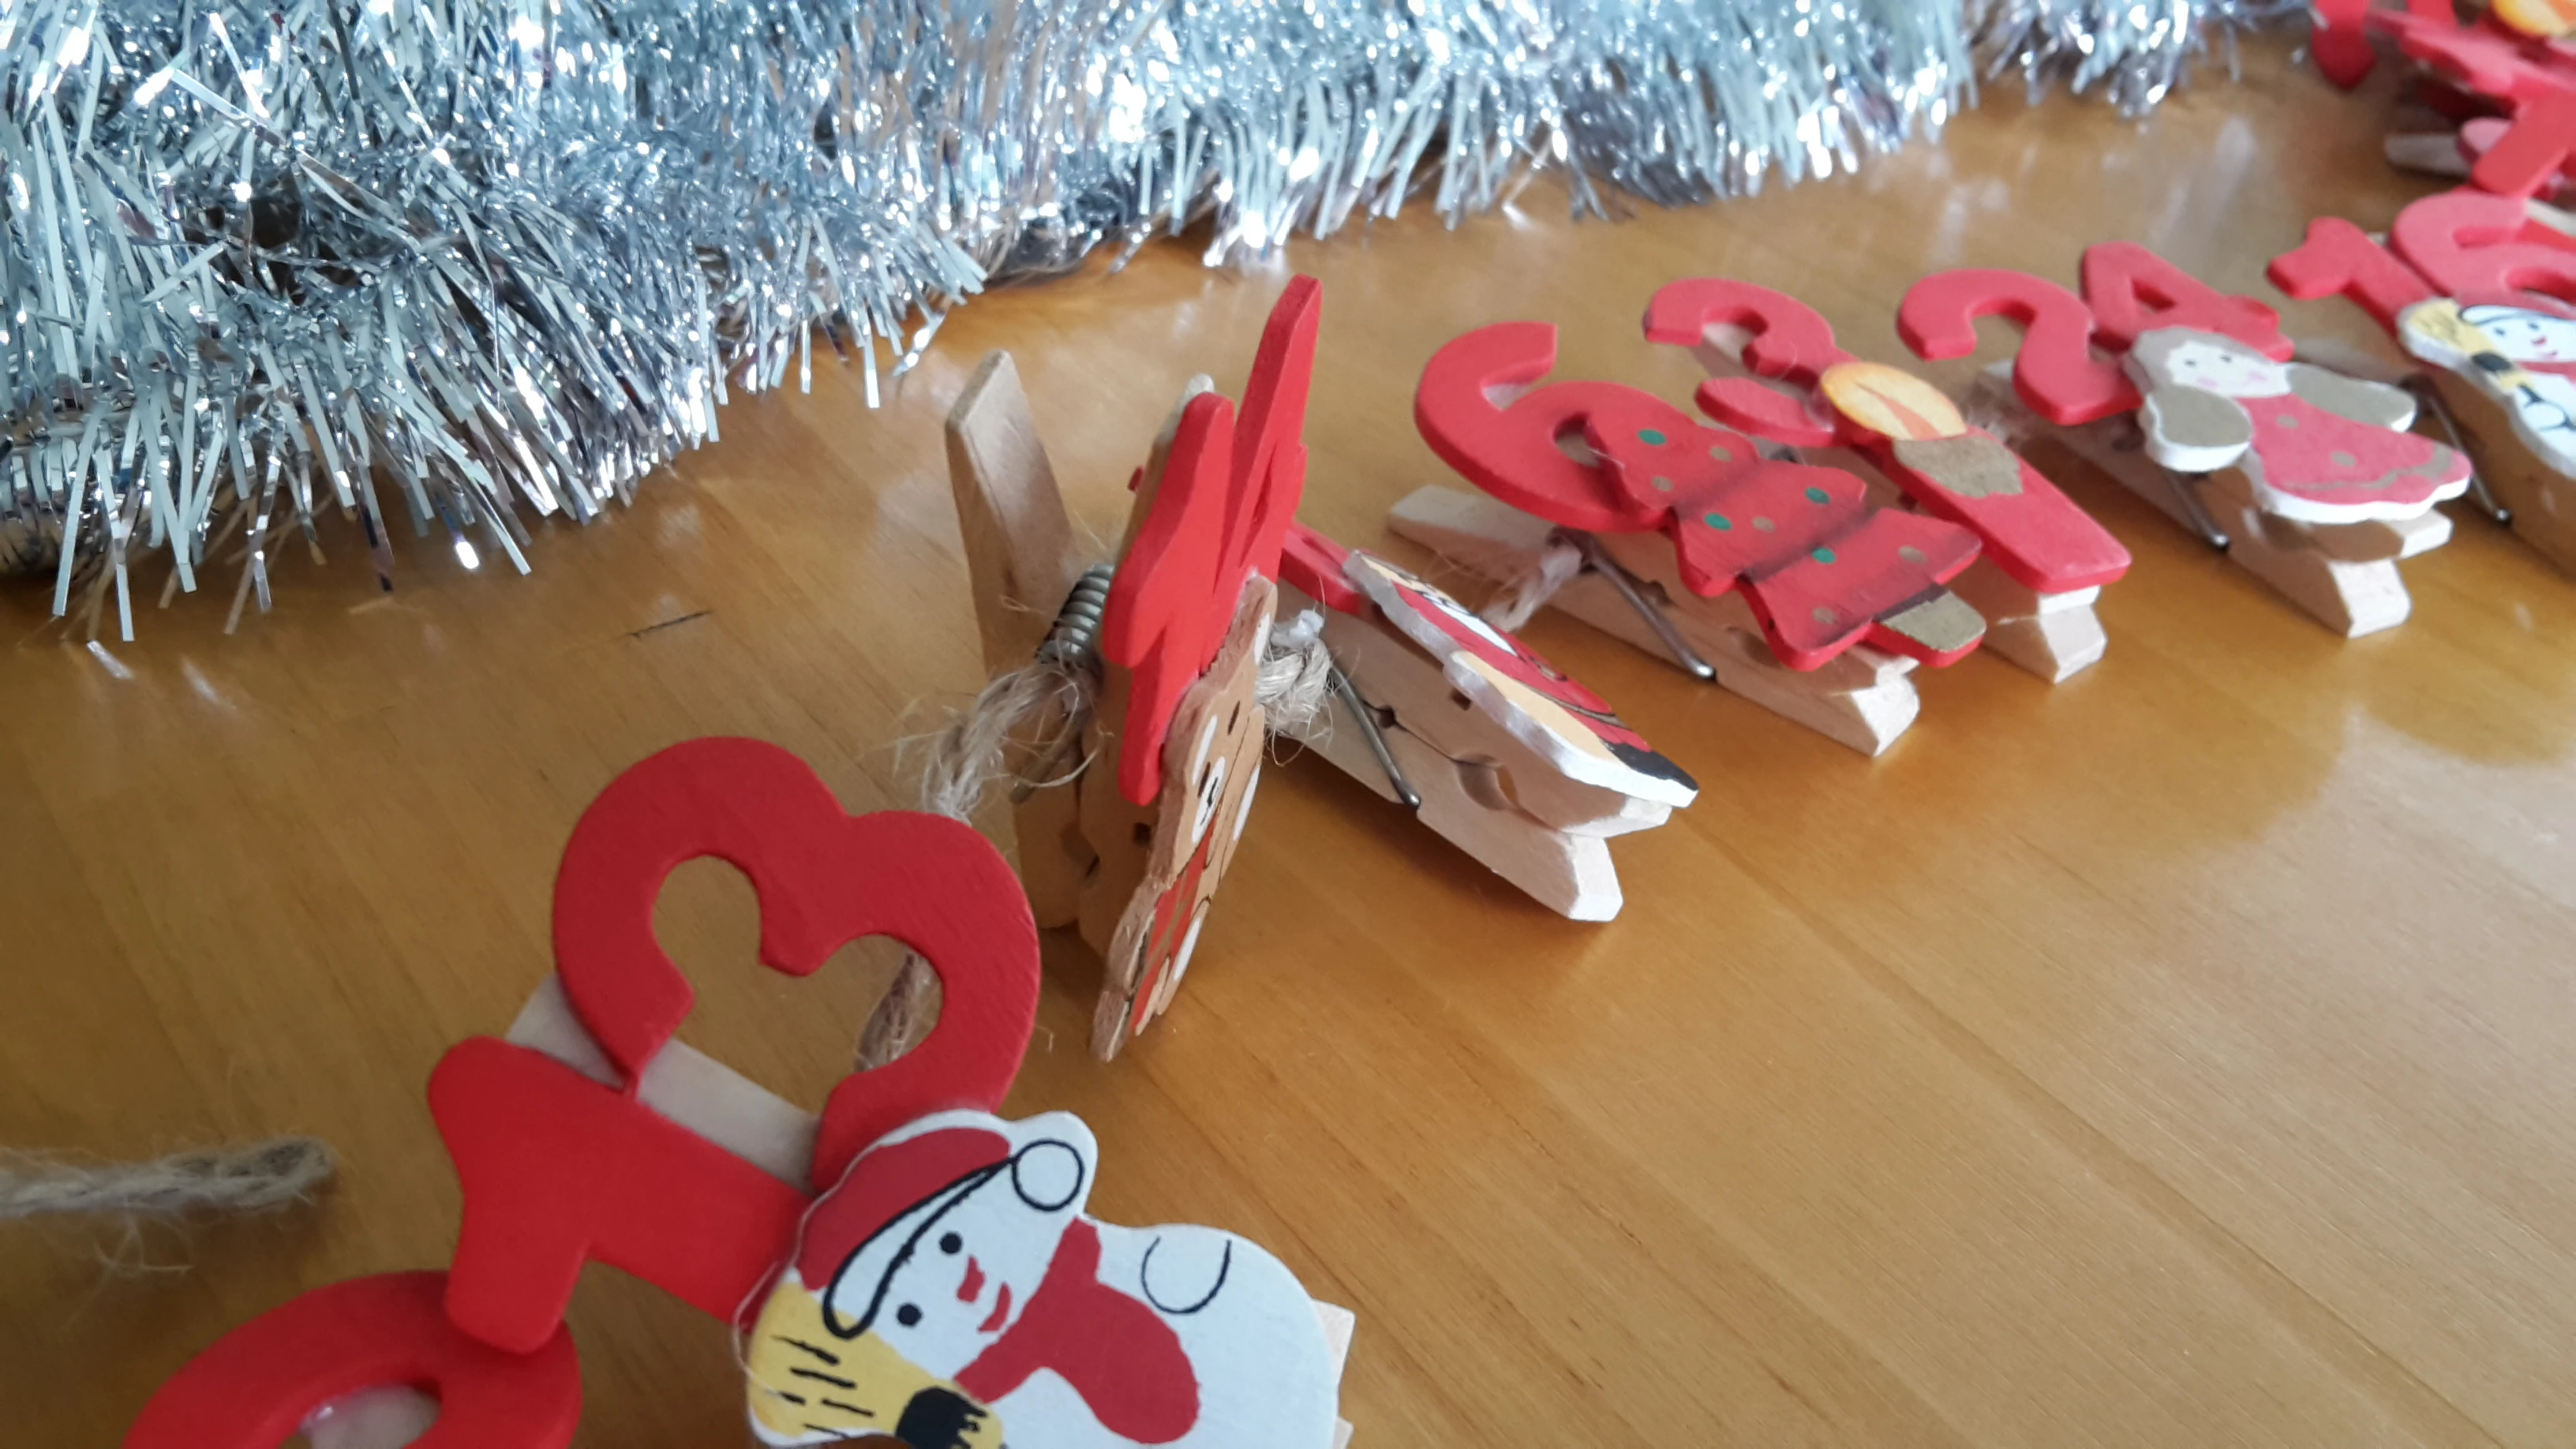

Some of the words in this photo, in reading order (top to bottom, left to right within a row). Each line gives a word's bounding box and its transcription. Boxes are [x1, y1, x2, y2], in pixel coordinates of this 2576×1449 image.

[1414, 322, 1697, 534] 6
[1642, 279, 1855, 447] 3
[1899, 241, 2294, 426] 24
[427, 736, 1040, 1354] 13
